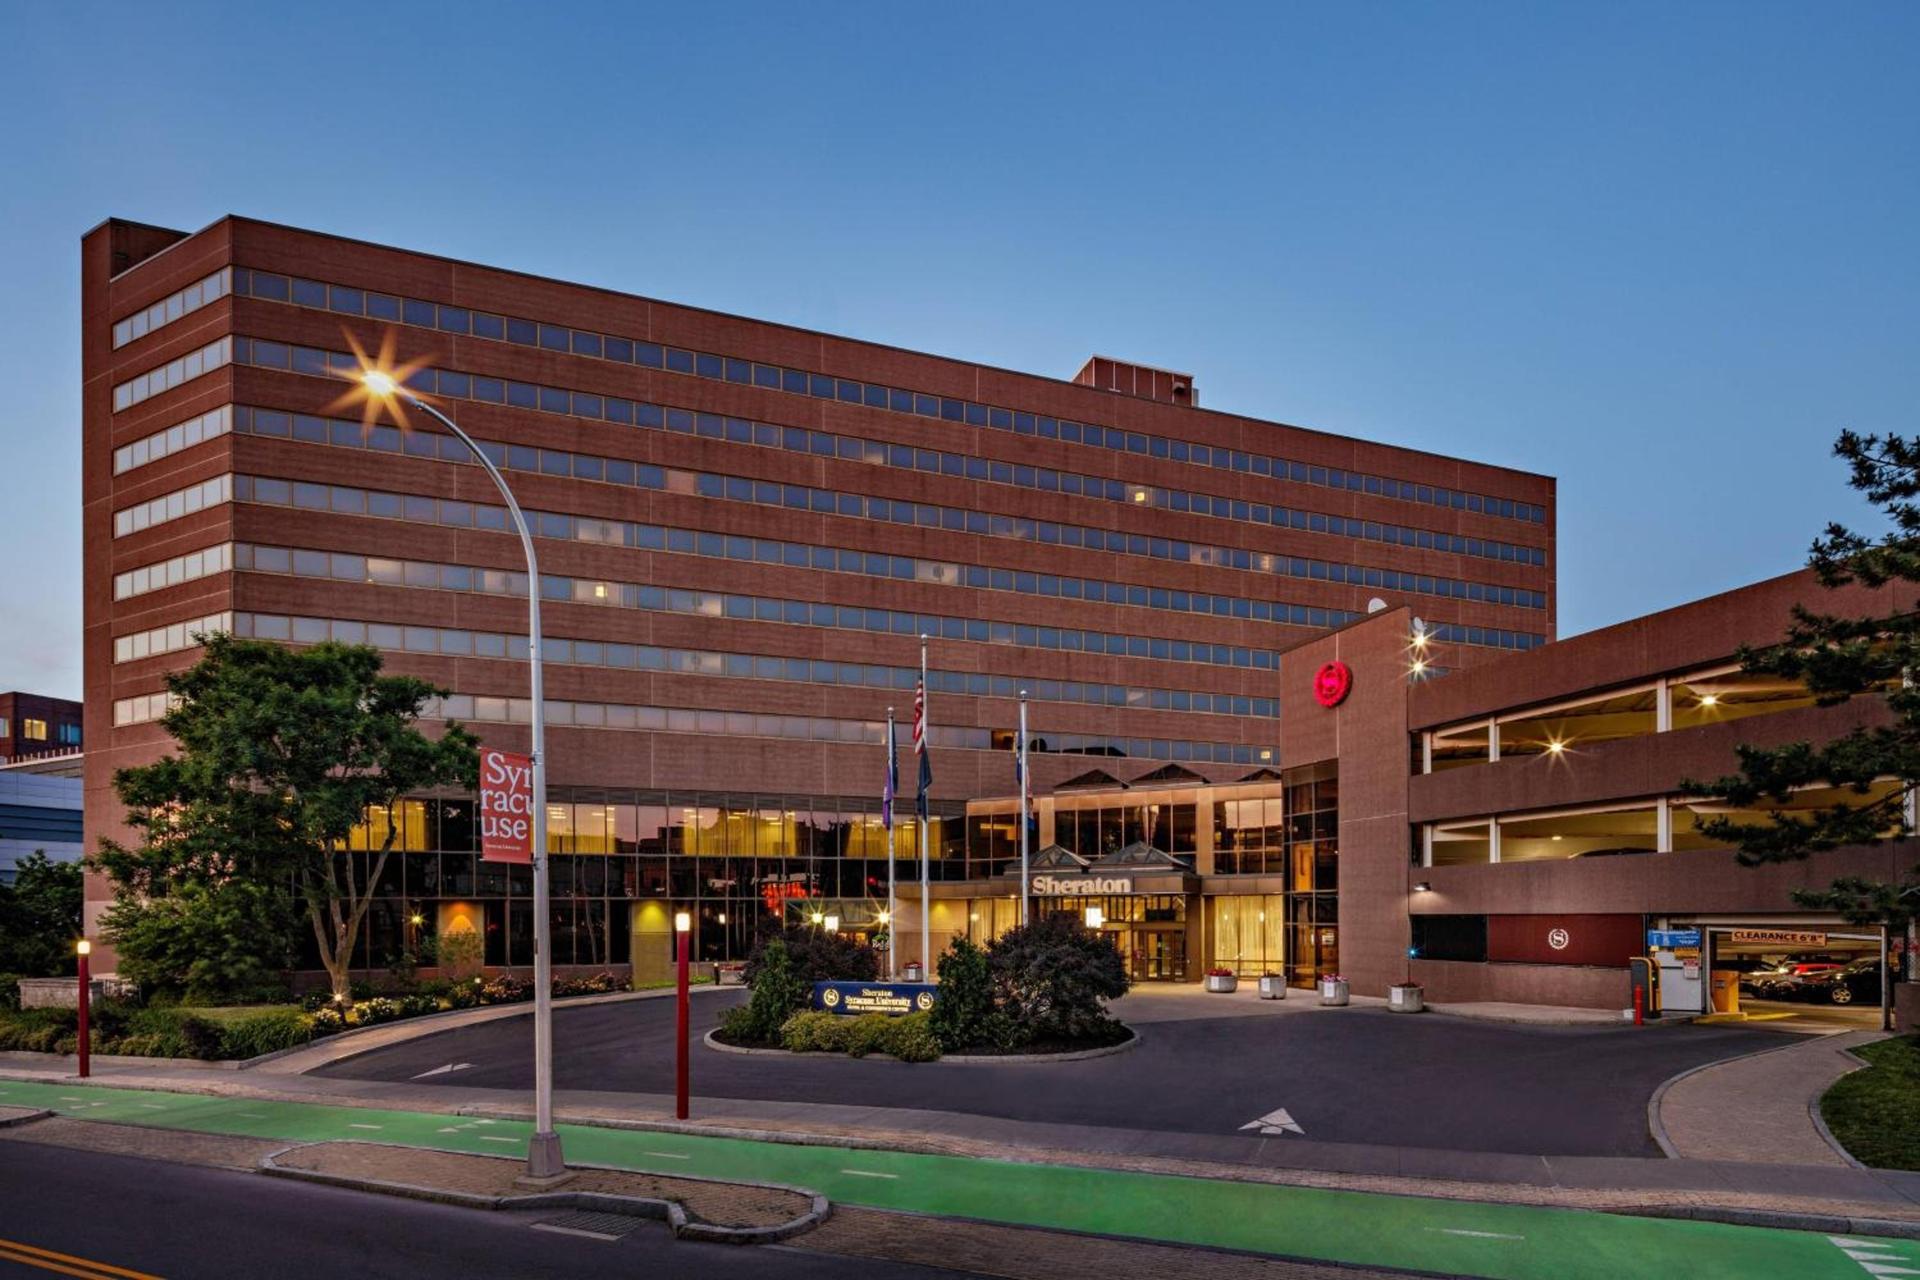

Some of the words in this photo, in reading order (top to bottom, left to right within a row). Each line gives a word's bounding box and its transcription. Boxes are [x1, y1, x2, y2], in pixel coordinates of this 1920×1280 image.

[481, 817, 528, 840] use
[1032, 876, 1131, 894] Sheraton
[1734, 931, 1797, 941] CLEARANCE
[862, 988, 893, 997] Sheraton
[875, 997, 912, 1007] University
